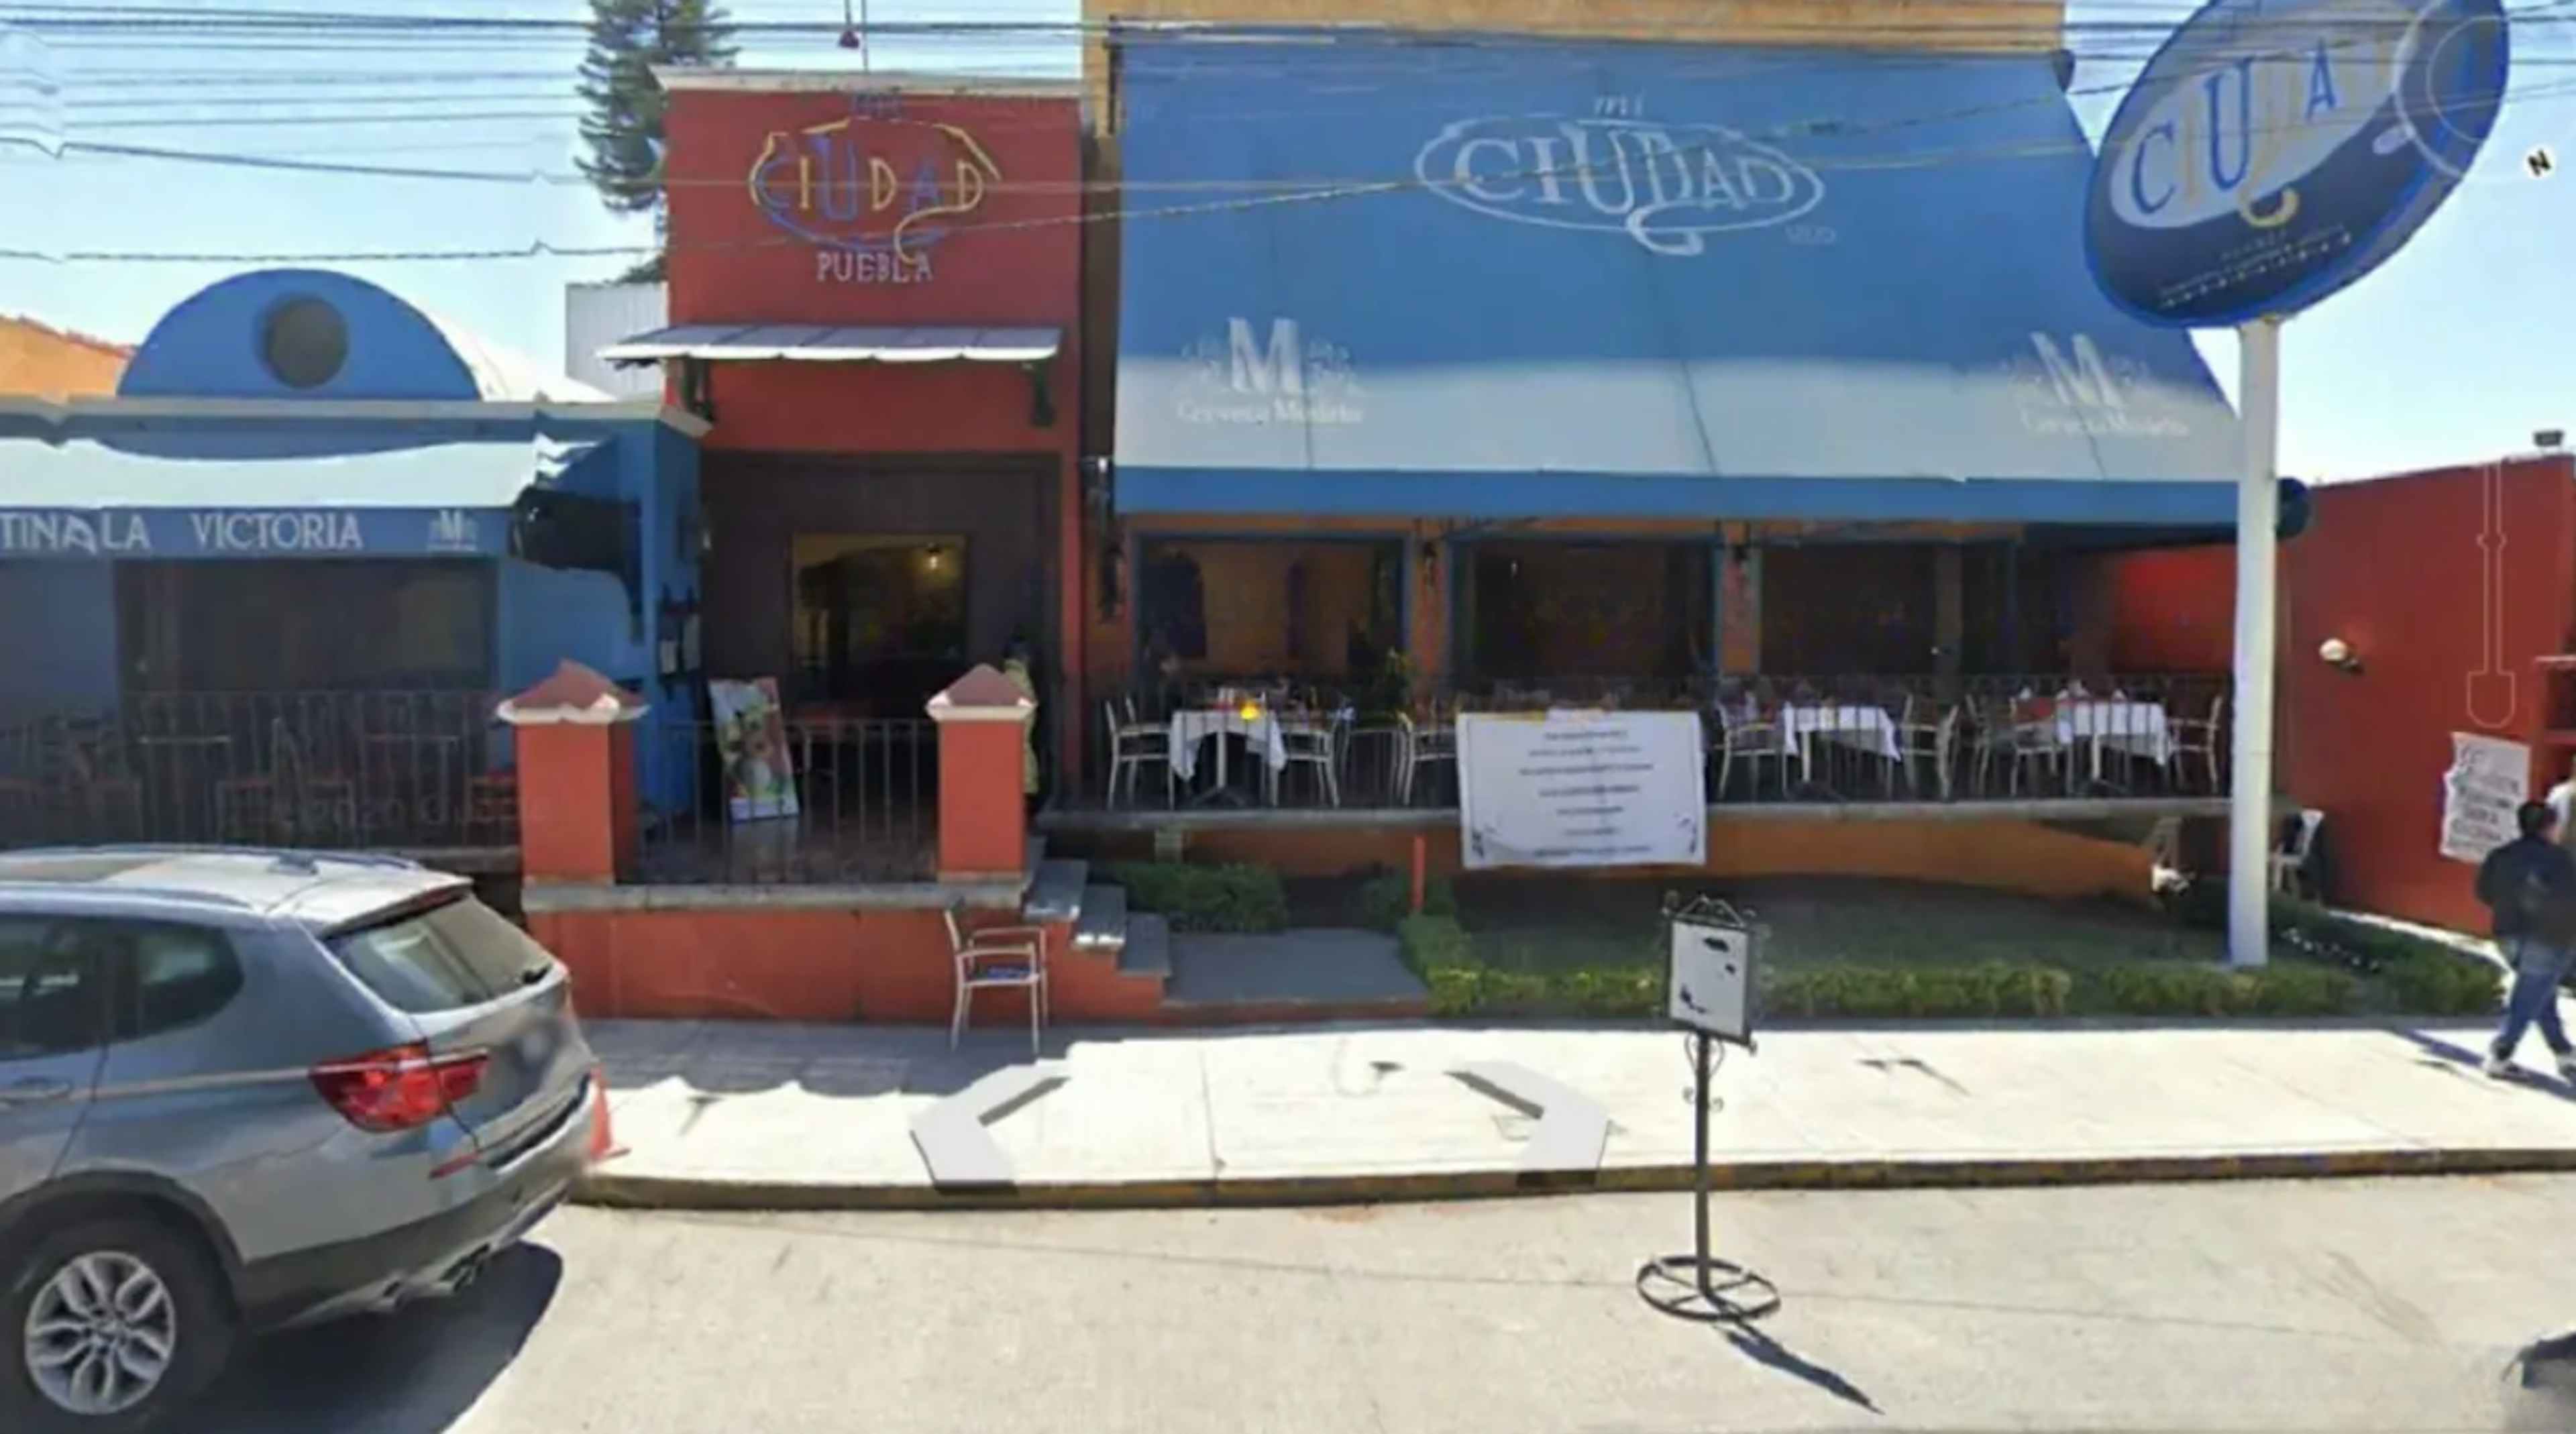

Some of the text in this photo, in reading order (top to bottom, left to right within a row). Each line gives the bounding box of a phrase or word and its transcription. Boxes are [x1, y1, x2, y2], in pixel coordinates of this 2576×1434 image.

[1453, 121, 1795, 256] CIUDAD
[816, 251, 934, 283] PUEBLA
[1227, 317, 1304, 394] M
[102, 512, 152, 549] LA
[190, 512, 364, 550] VICTORIA
